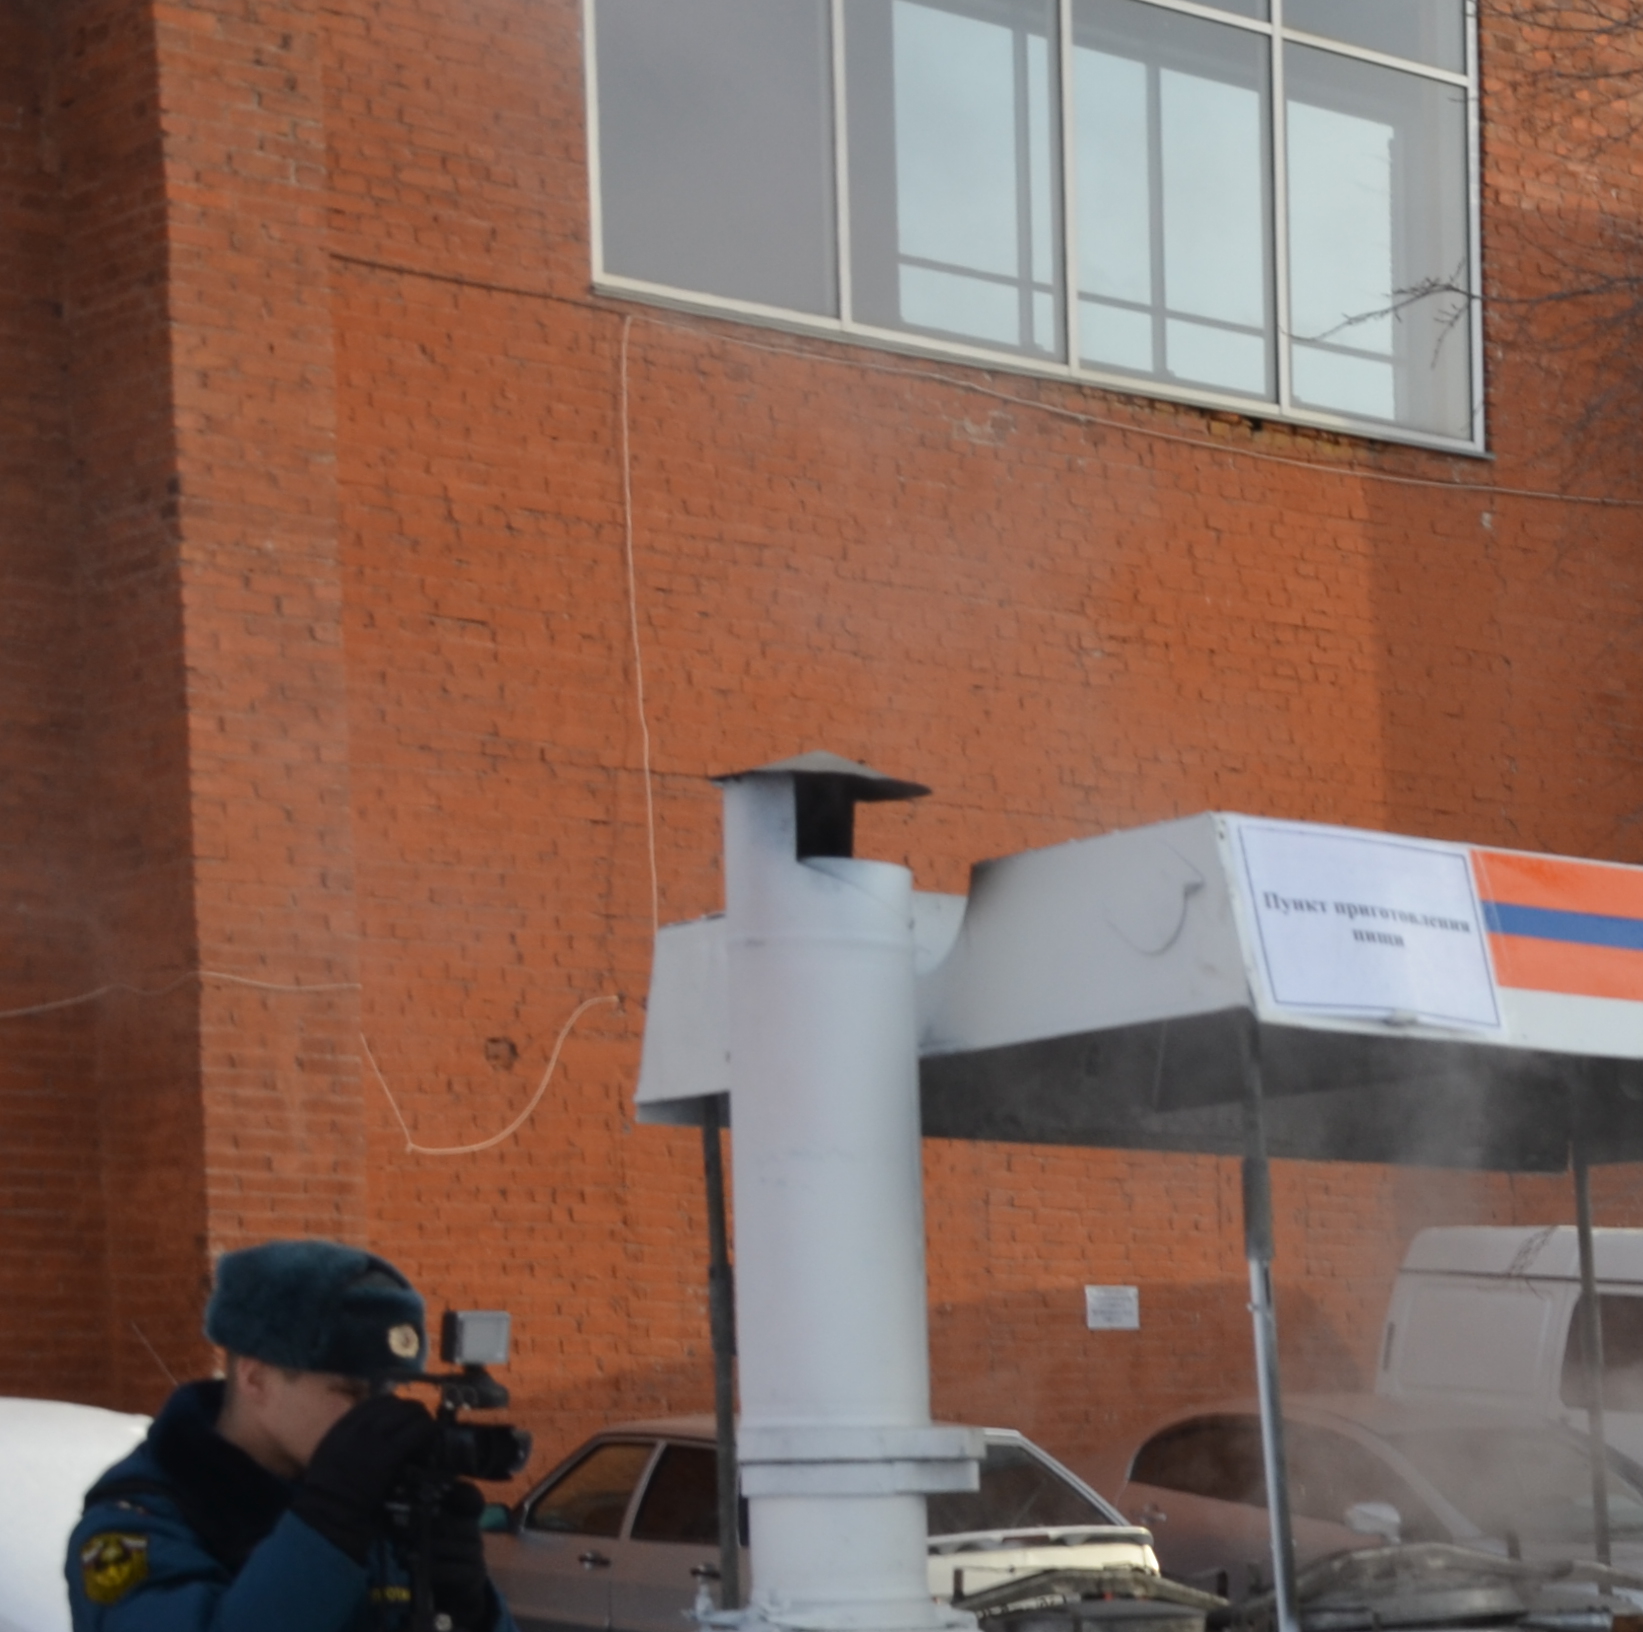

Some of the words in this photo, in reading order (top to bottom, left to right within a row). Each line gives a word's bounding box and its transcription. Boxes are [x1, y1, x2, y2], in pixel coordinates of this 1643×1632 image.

[1263, 891, 1327, 915] Пункт
[1334, 901, 1471, 934] приготовления
[1353, 928, 1405, 948] пищи
